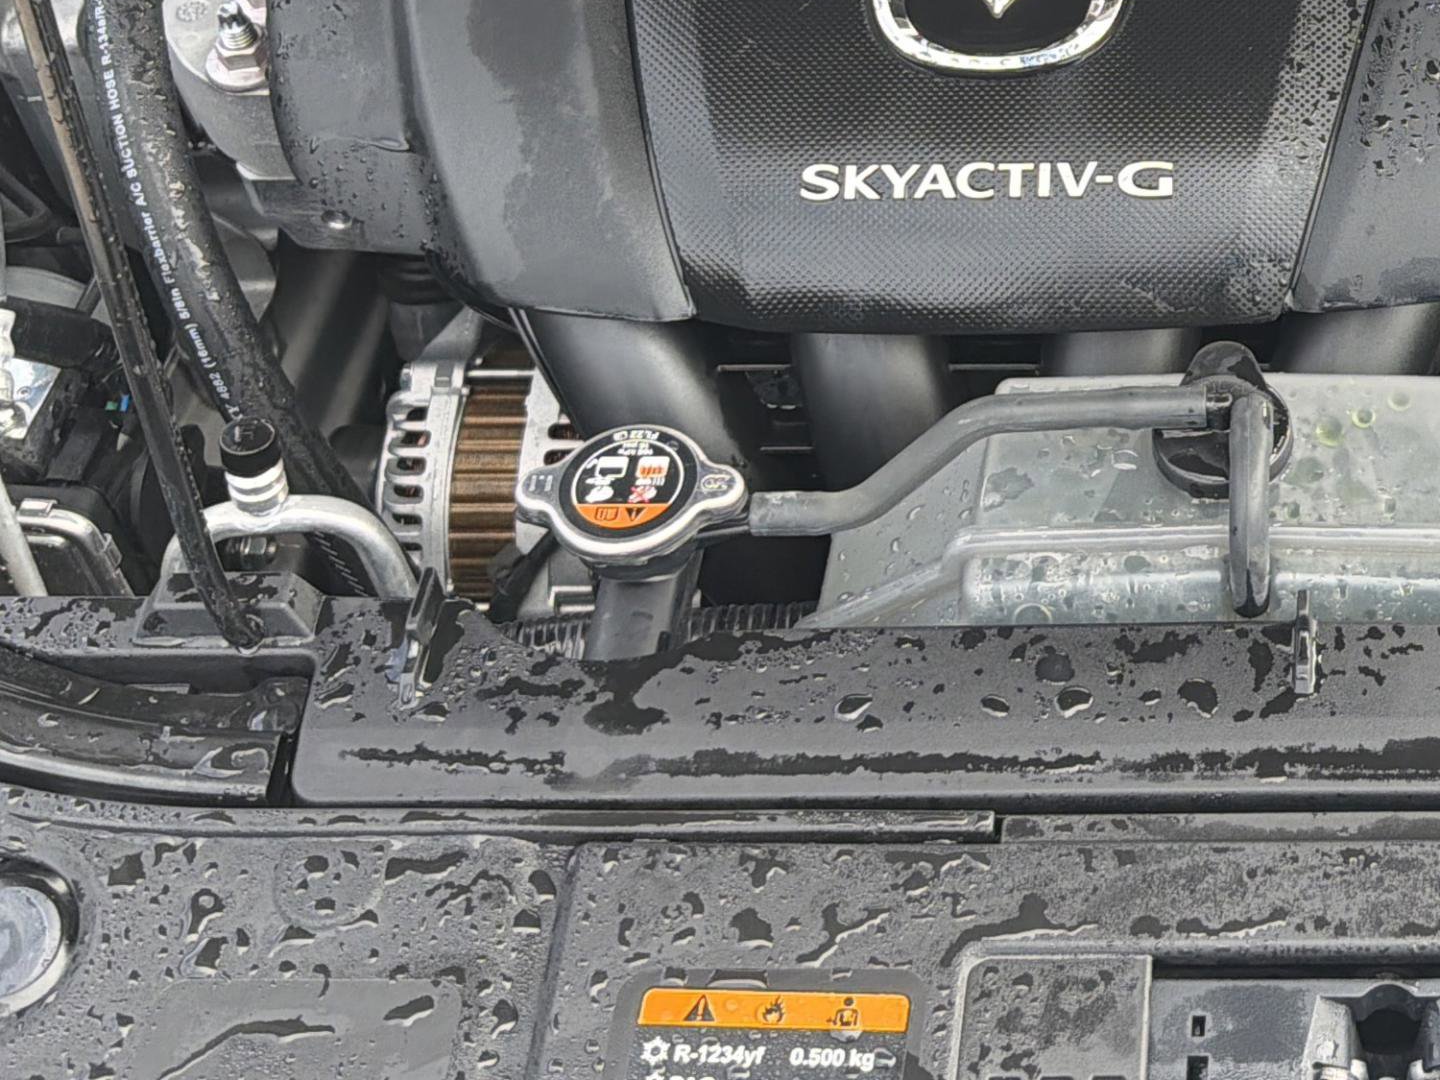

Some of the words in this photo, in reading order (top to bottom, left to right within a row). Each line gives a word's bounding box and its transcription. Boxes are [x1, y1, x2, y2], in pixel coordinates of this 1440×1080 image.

[102, 69, 121, 111] HOSE
[111, 113, 138, 179] SUCTION
[129, 181, 148, 207] A/C
[800, 160, 1175, 201] SKYACTIV-G
[672, 1043, 767, 1068] R-1234yf
[789, 1046, 845, 1068] 0.500
[848, 1047, 876, 1072] kg
